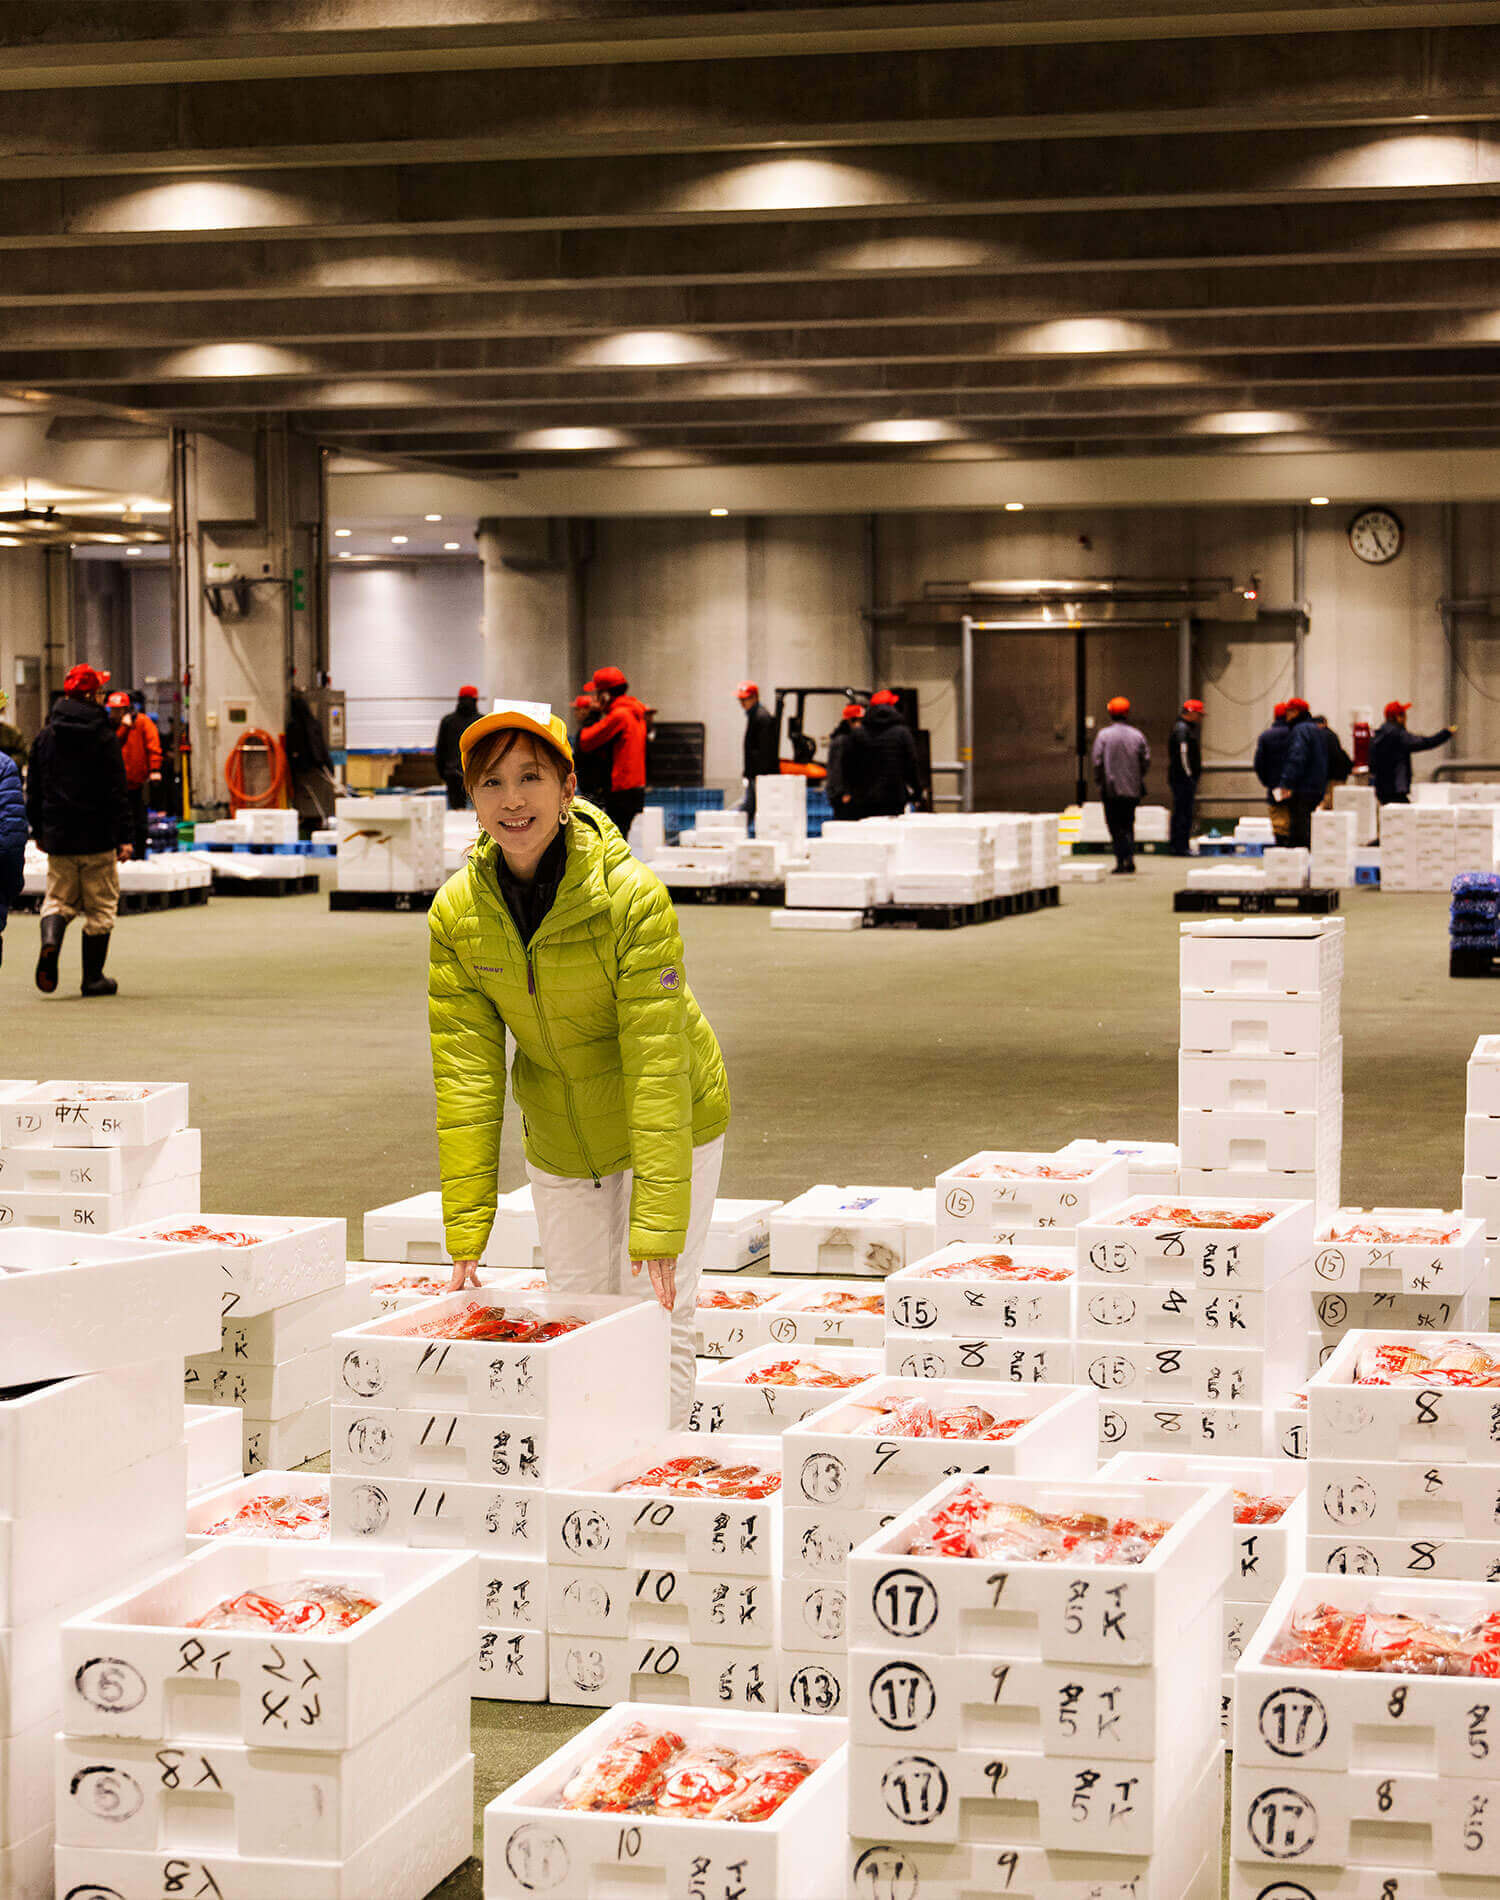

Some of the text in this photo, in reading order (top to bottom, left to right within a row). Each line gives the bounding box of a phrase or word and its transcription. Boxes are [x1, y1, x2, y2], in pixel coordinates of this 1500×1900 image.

[55, 1103, 89, 1124] 中大
[1059, 1193, 1078, 1207] 10
[73, 1209, 95, 1224] 5K
[1155, 1230, 1186, 1257] 8
[1202, 1258, 1241, 1278] 5K
[1431, 1258, 1444, 1275] 4
[1439, 1303, 1451, 1324] 7
[728, 1328, 744, 1342] 13
[959, 1341, 989, 1368] 8
[1156, 1350, 1182, 1374] 8
[1415, 1390, 1443, 1424] 8
[1154, 1411, 1183, 1432] 8
[413, 1487, 446, 1517] 11
[633, 1499, 674, 1527] 10
[711, 1531, 758, 1556] 5K
[1406, 1541, 1446, 1571] 8
[635, 1568, 677, 1603] 10
[710, 1599, 758, 1626] 5K
[1064, 1605, 1128, 1642] 5K
[478, 1650, 525, 1677] 5K
[639, 1645, 680, 1676] 10
[718, 1677, 766, 1705] 5K
[1387, 1685, 1409, 1718] 8
[1058, 1708, 1121, 1743] 5K
[1375, 1779, 1398, 1812] 8
[1071, 1792, 1134, 1828] 5K
[617, 1826, 643, 1861] 10
